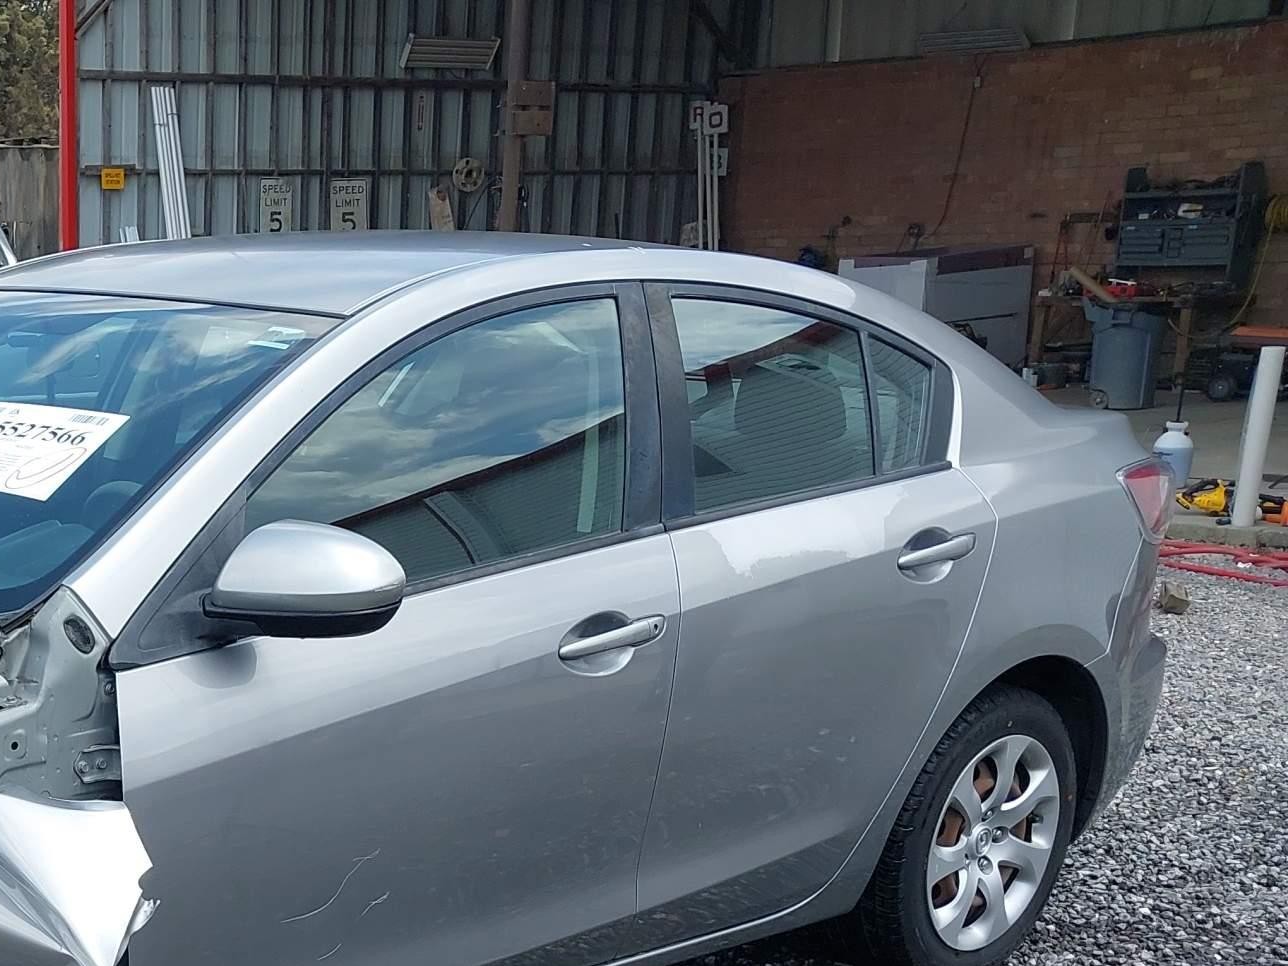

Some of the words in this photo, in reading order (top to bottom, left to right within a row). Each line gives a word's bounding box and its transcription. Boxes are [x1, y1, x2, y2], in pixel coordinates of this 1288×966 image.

[262, 184, 291, 193] SPEED
[332, 185, 364, 195] SPEED
[264, 197, 288, 206] LIMIT
[335, 198, 360, 207] LIMIT
[270, 211, 282, 232] 5
[342, 211, 356, 230] 5
